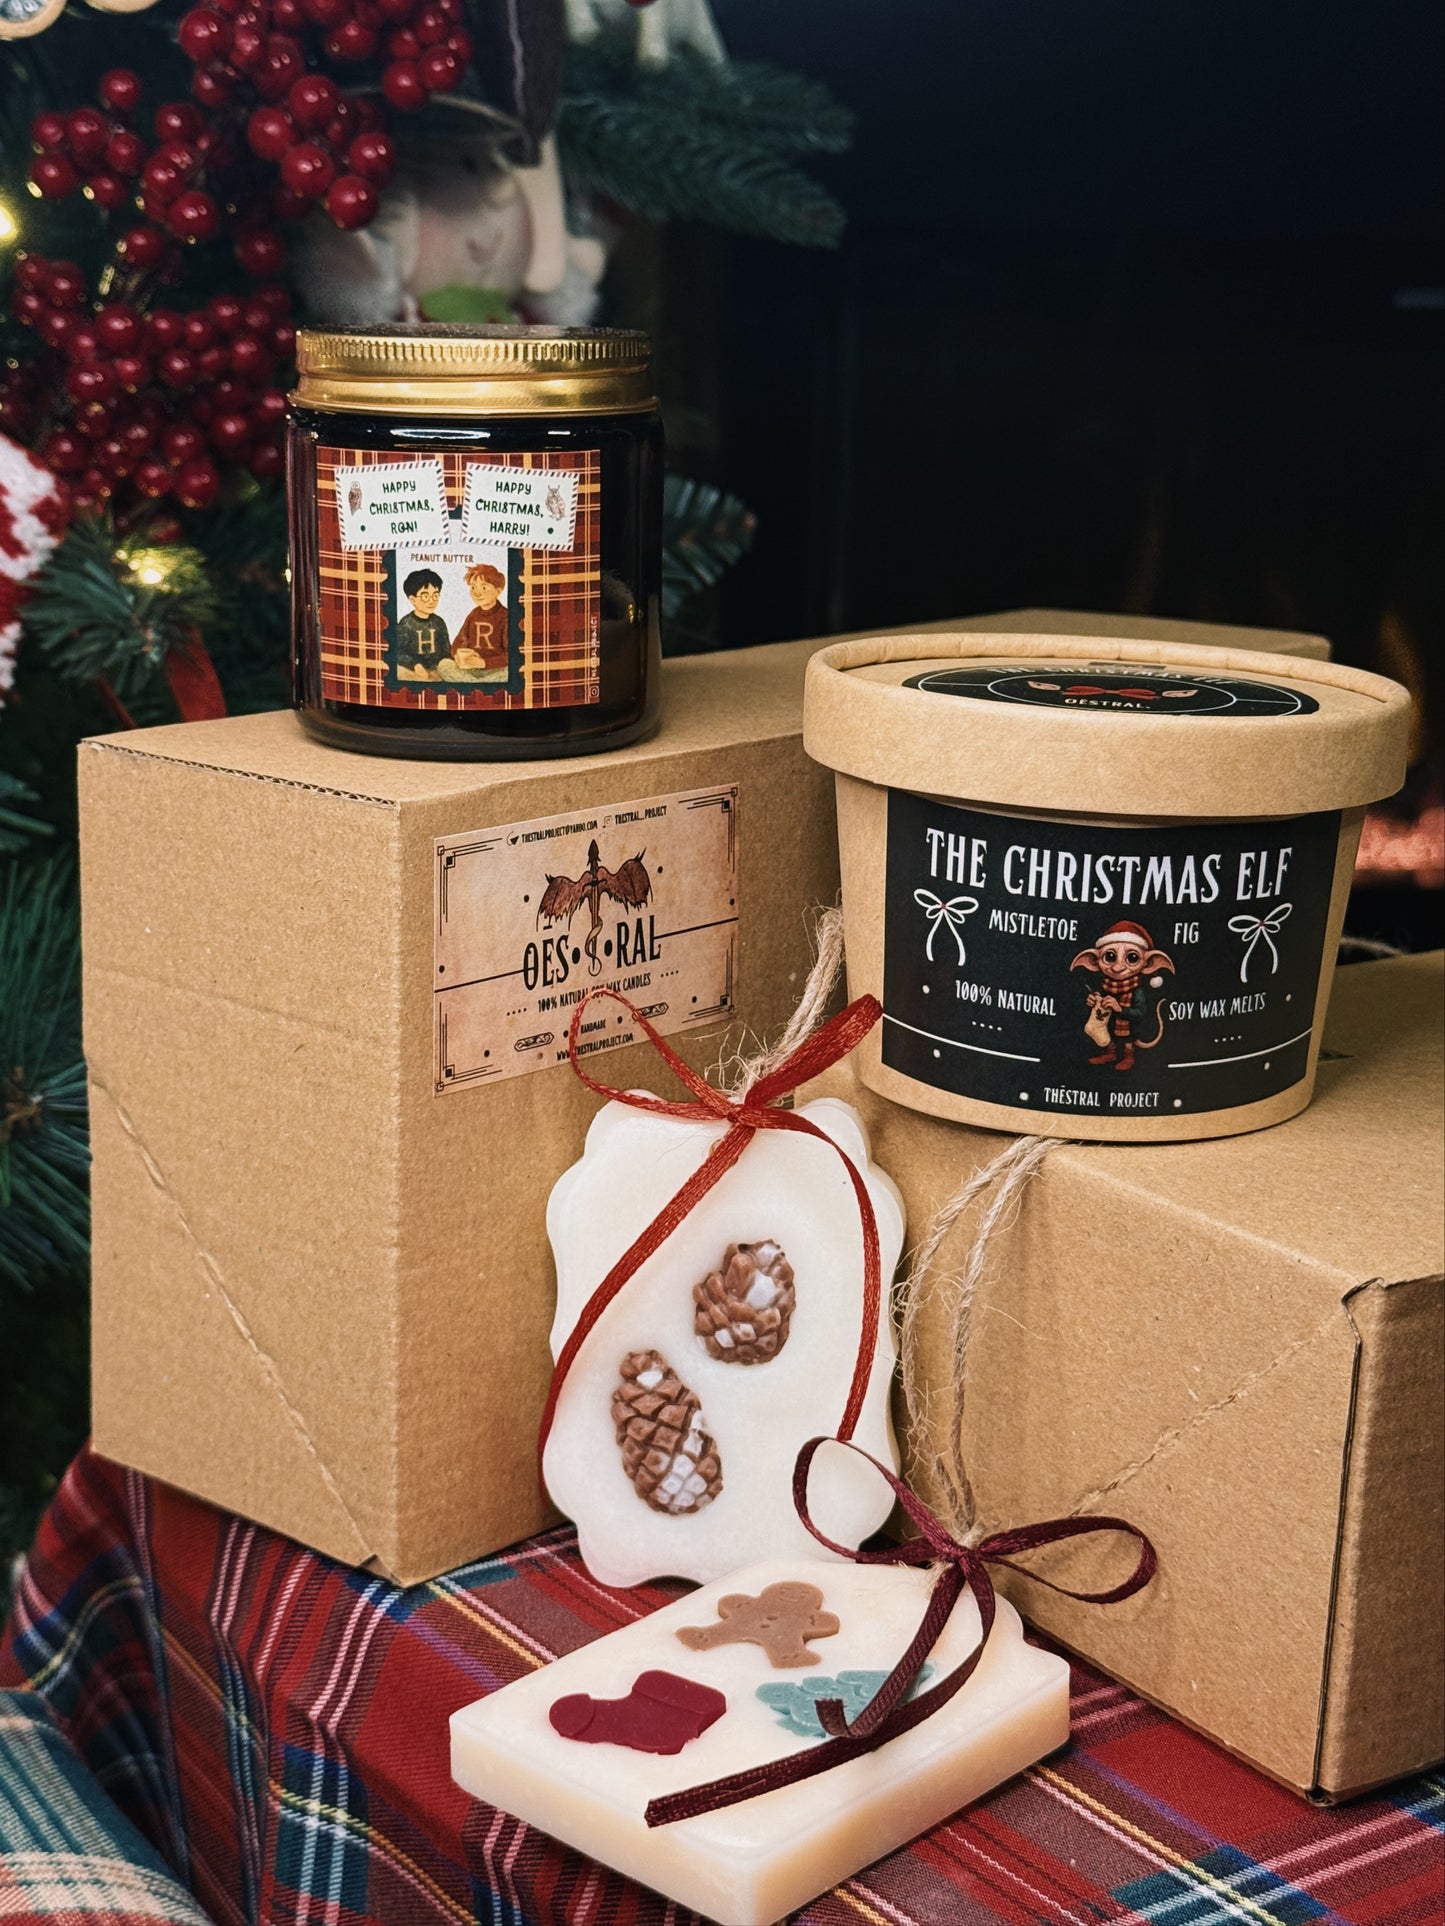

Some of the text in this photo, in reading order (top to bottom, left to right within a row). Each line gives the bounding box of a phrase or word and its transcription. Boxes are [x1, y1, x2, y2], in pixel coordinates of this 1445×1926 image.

[382, 481, 416, 493] HAPPY
[496, 481, 532, 495] HAPPY
[369, 501, 434, 515] CHRISTMAS,
[475, 499, 544, 518] CHRISTMAS,
[391, 521, 418, 533] RON!
[490, 521, 530, 535] HARRY!
[410, 553, 474, 563] PEANUT BUTTER
[416, 628, 436, 655] H
[474, 621, 495, 649] R
[926, 827, 1293, 905] THE CHRISTMAS ELF
[989, 909, 1199, 945] MISTLETOE FIG
[538, 996, 557, 1012] 100%
[606, 979, 621, 992] WAX
[623, 972, 651, 991] CANDLES
[955, 979, 1056, 1017] 100% NATURAL
[1168, 991, 1266, 1021] SOY WAX MELTS
[1109, 1092, 1159, 1108] PROJECT
